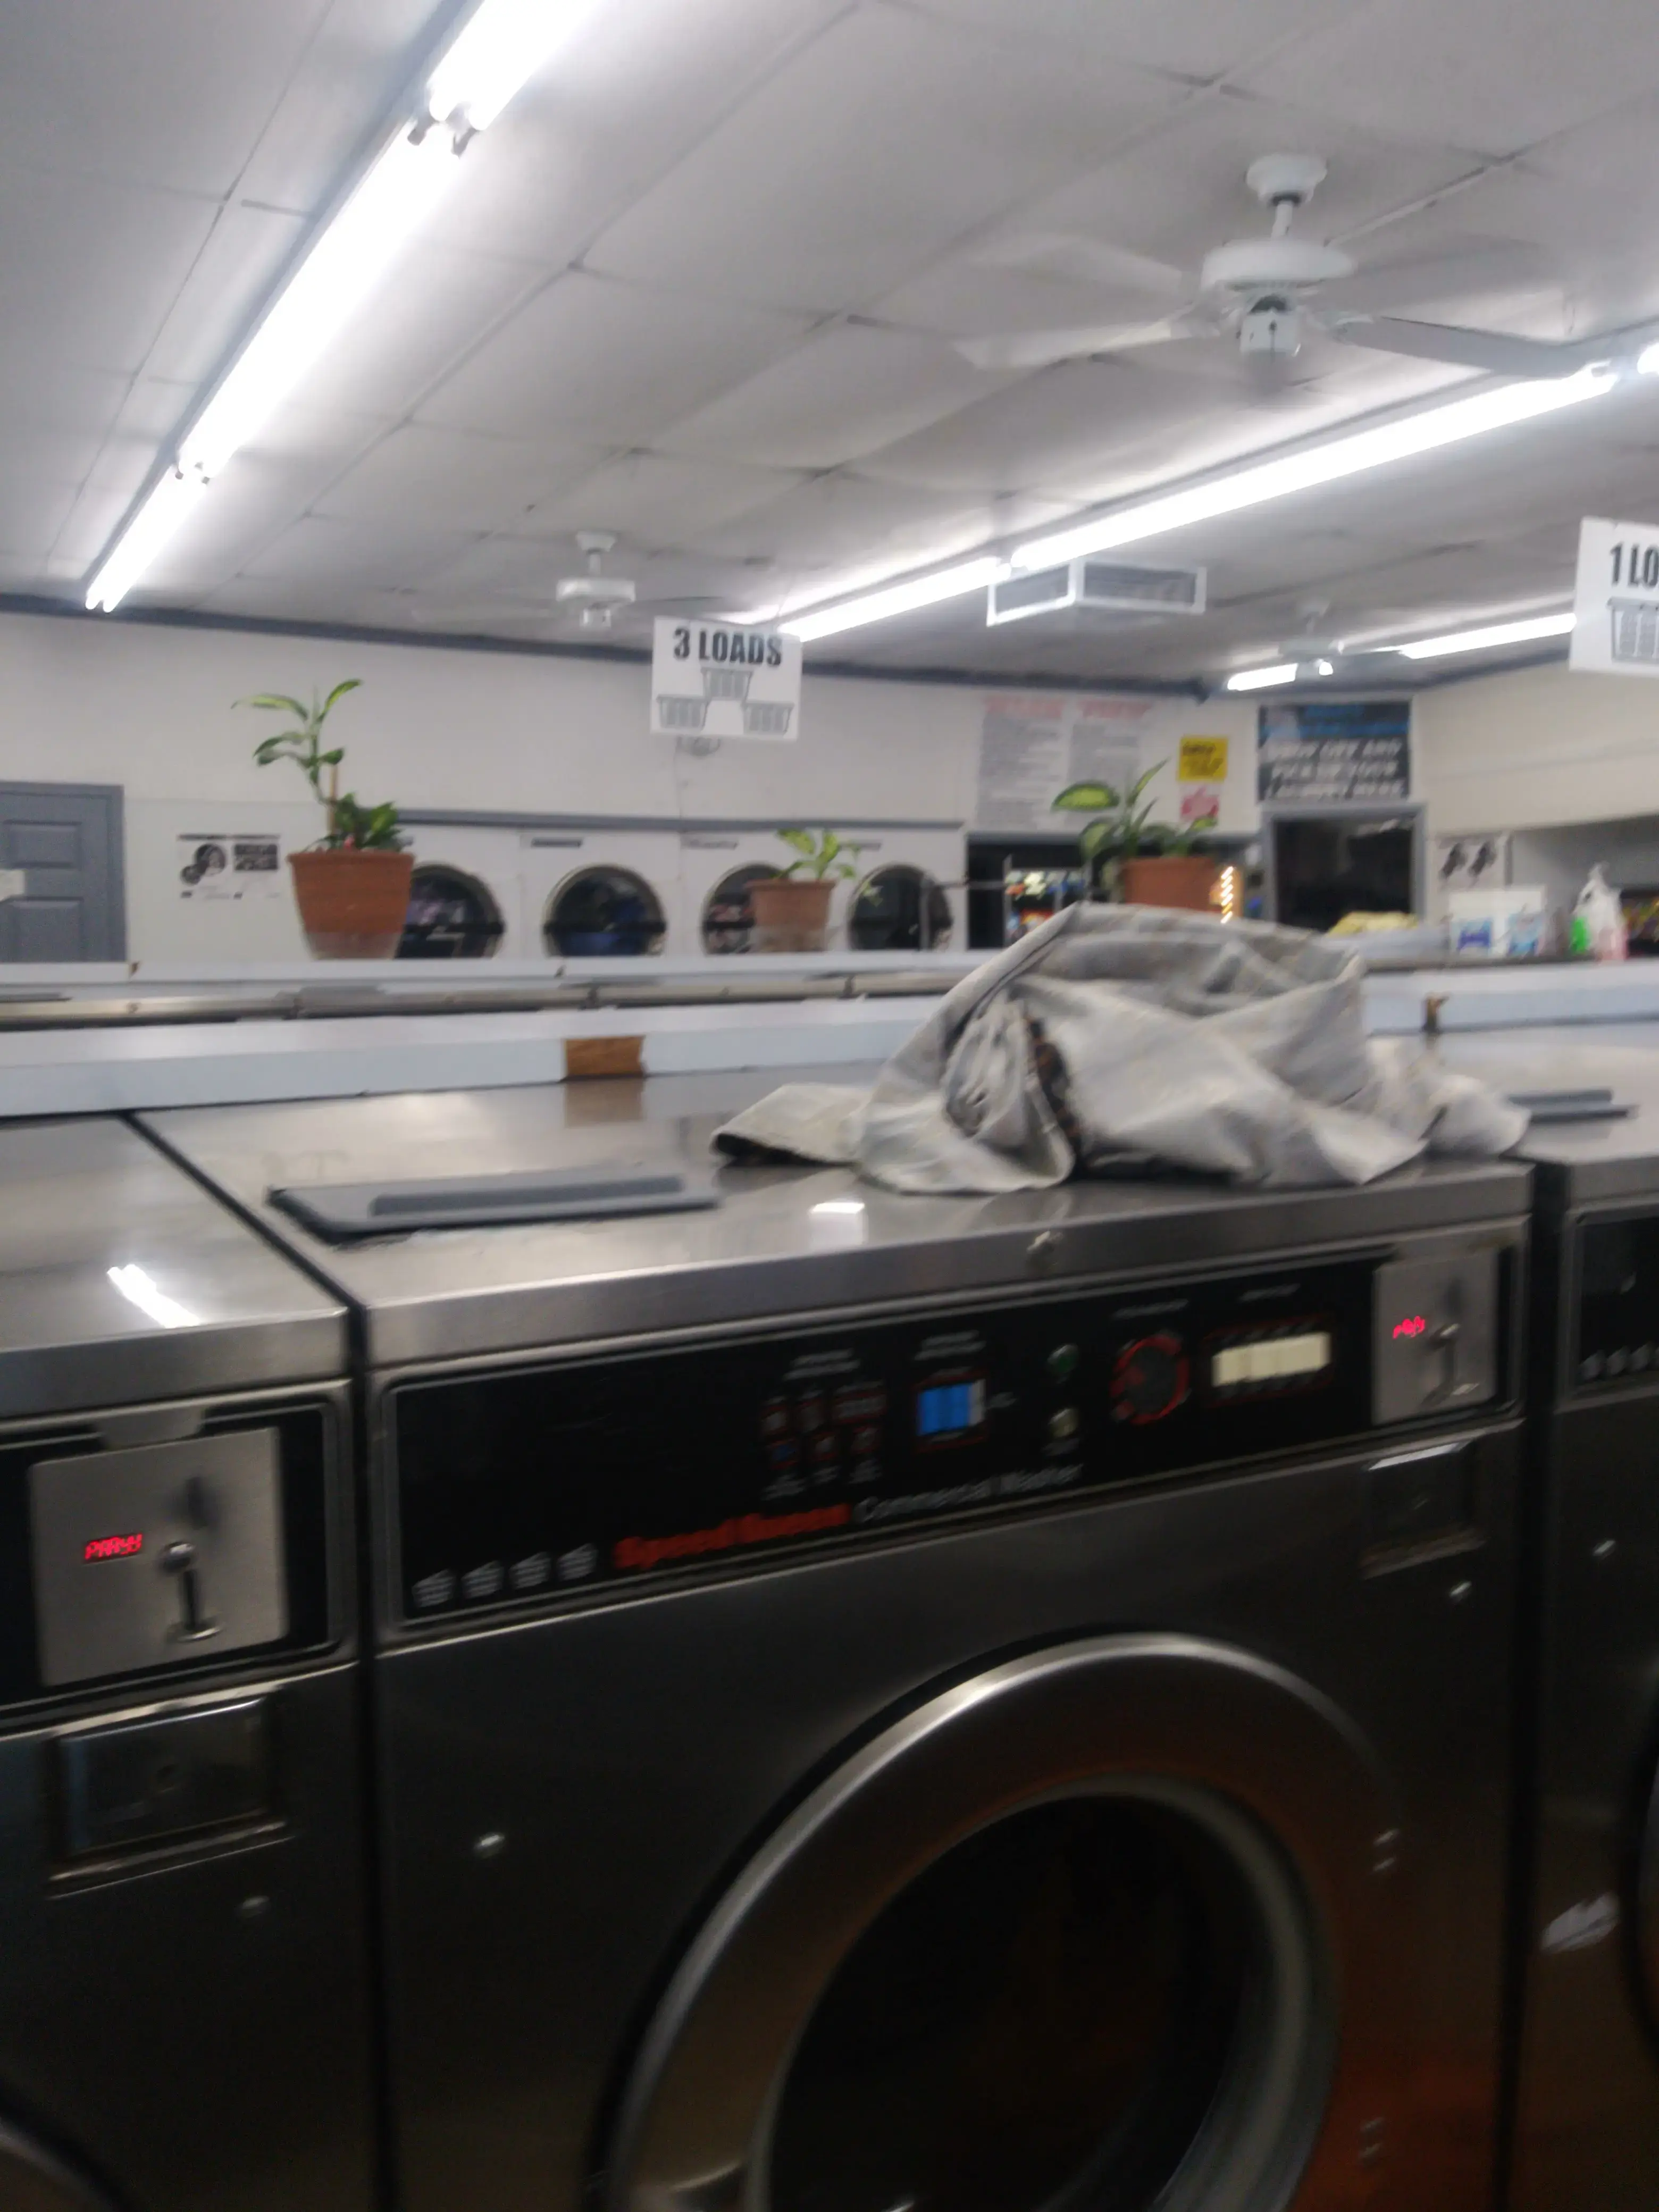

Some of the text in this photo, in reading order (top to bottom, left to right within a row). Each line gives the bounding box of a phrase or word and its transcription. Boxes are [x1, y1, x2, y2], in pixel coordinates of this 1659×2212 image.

[1610, 542, 1622, 584] 1
[674, 627, 782, 666] 3 LOADS
